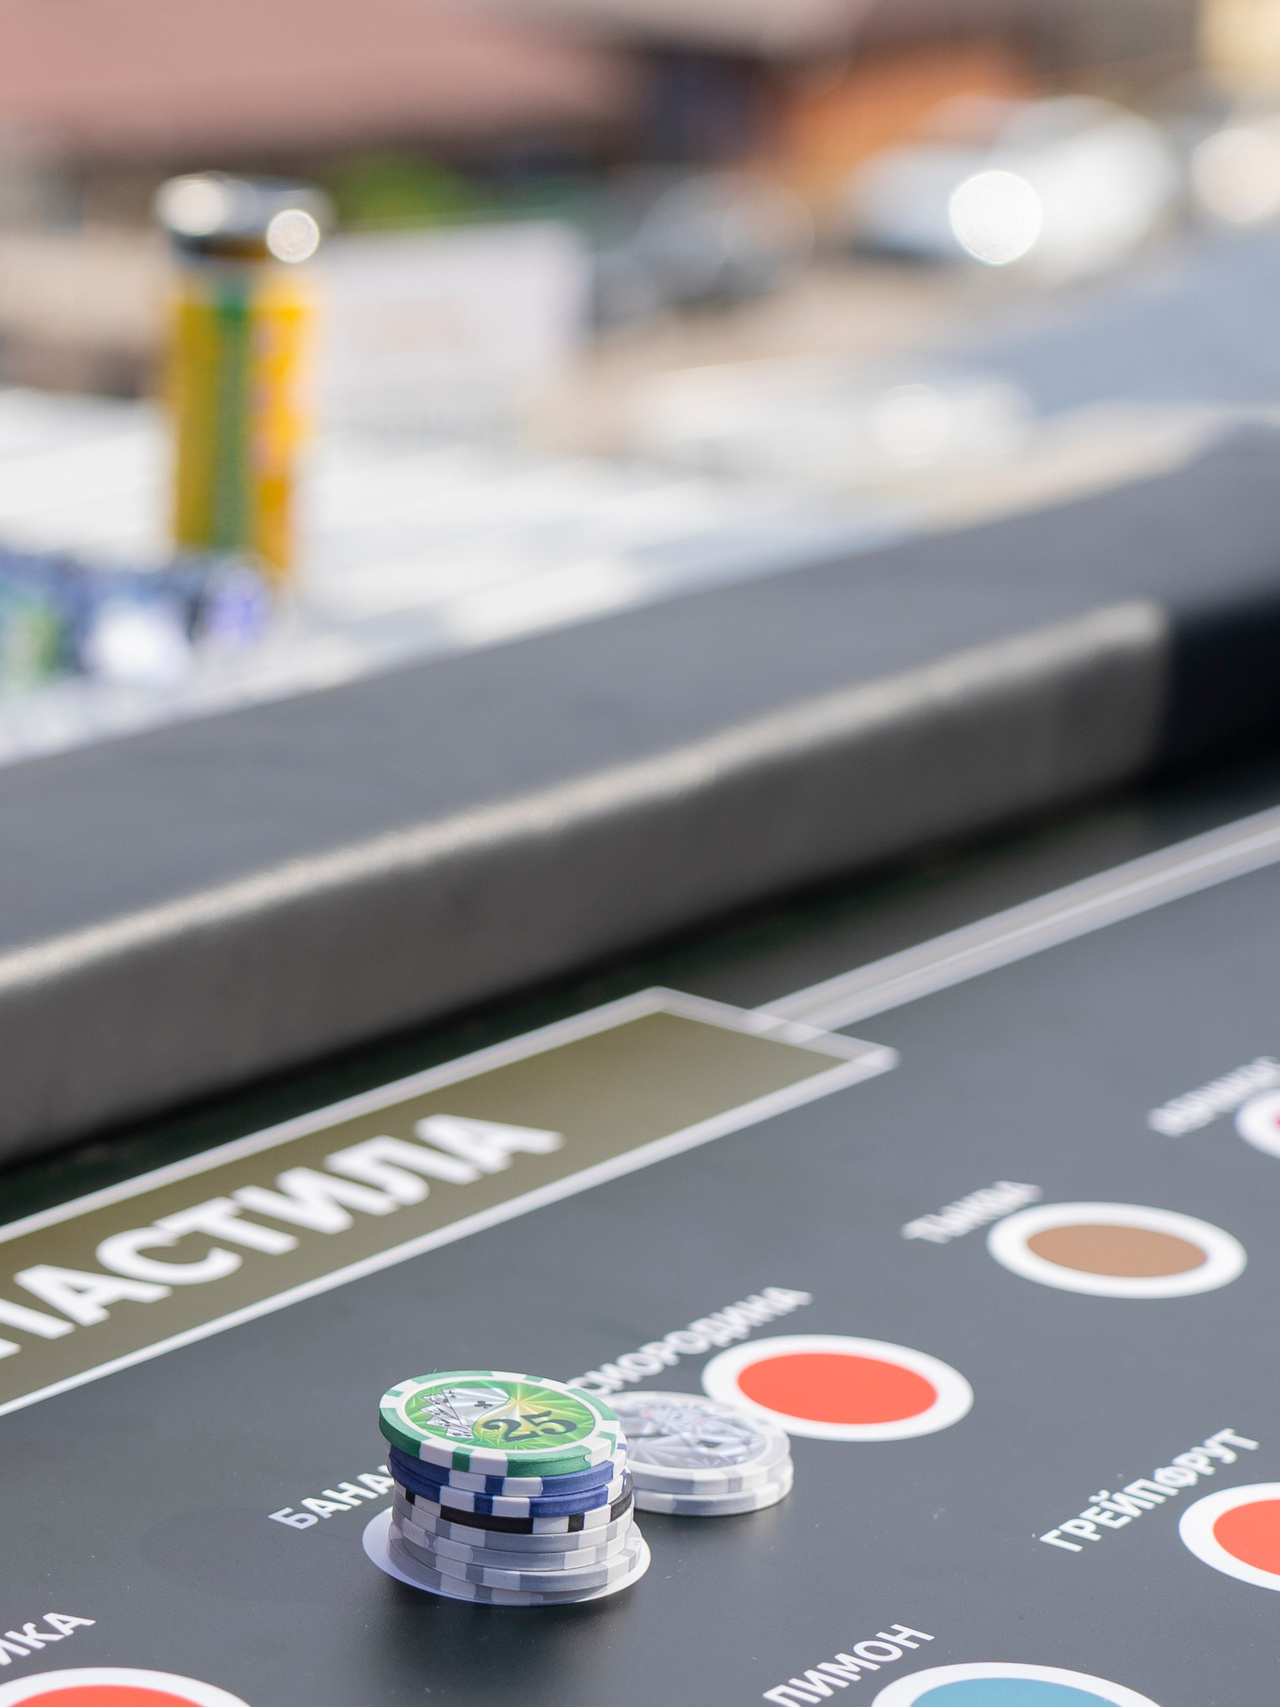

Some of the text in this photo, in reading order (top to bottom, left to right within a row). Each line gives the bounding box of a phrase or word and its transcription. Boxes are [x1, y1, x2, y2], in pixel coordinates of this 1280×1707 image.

[482, 1410, 577, 1442] 25
[268, 1464, 395, 1530] БАНА
[1039, 1427, 1259, 1553] ГРЕЙПФРУТ
[762, 1623, 935, 1707] ЛИМОН
